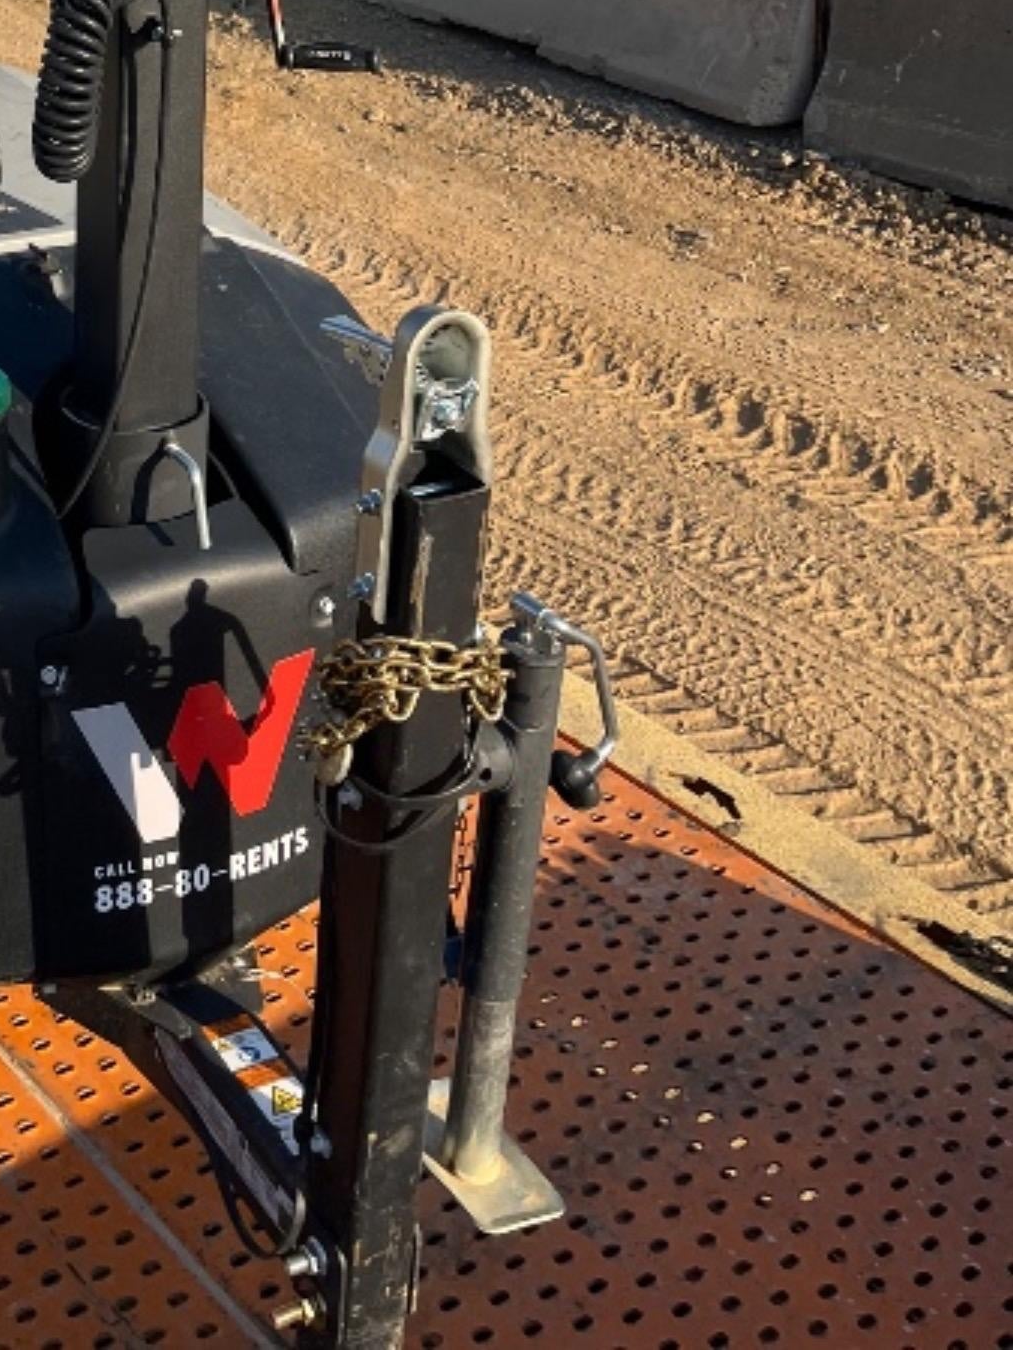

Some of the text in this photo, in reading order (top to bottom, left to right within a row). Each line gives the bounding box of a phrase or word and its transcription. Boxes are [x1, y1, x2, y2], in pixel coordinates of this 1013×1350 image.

[94, 851, 180, 879] CALL NOW
[94, 826, 310, 913] 888-80-RENTS
